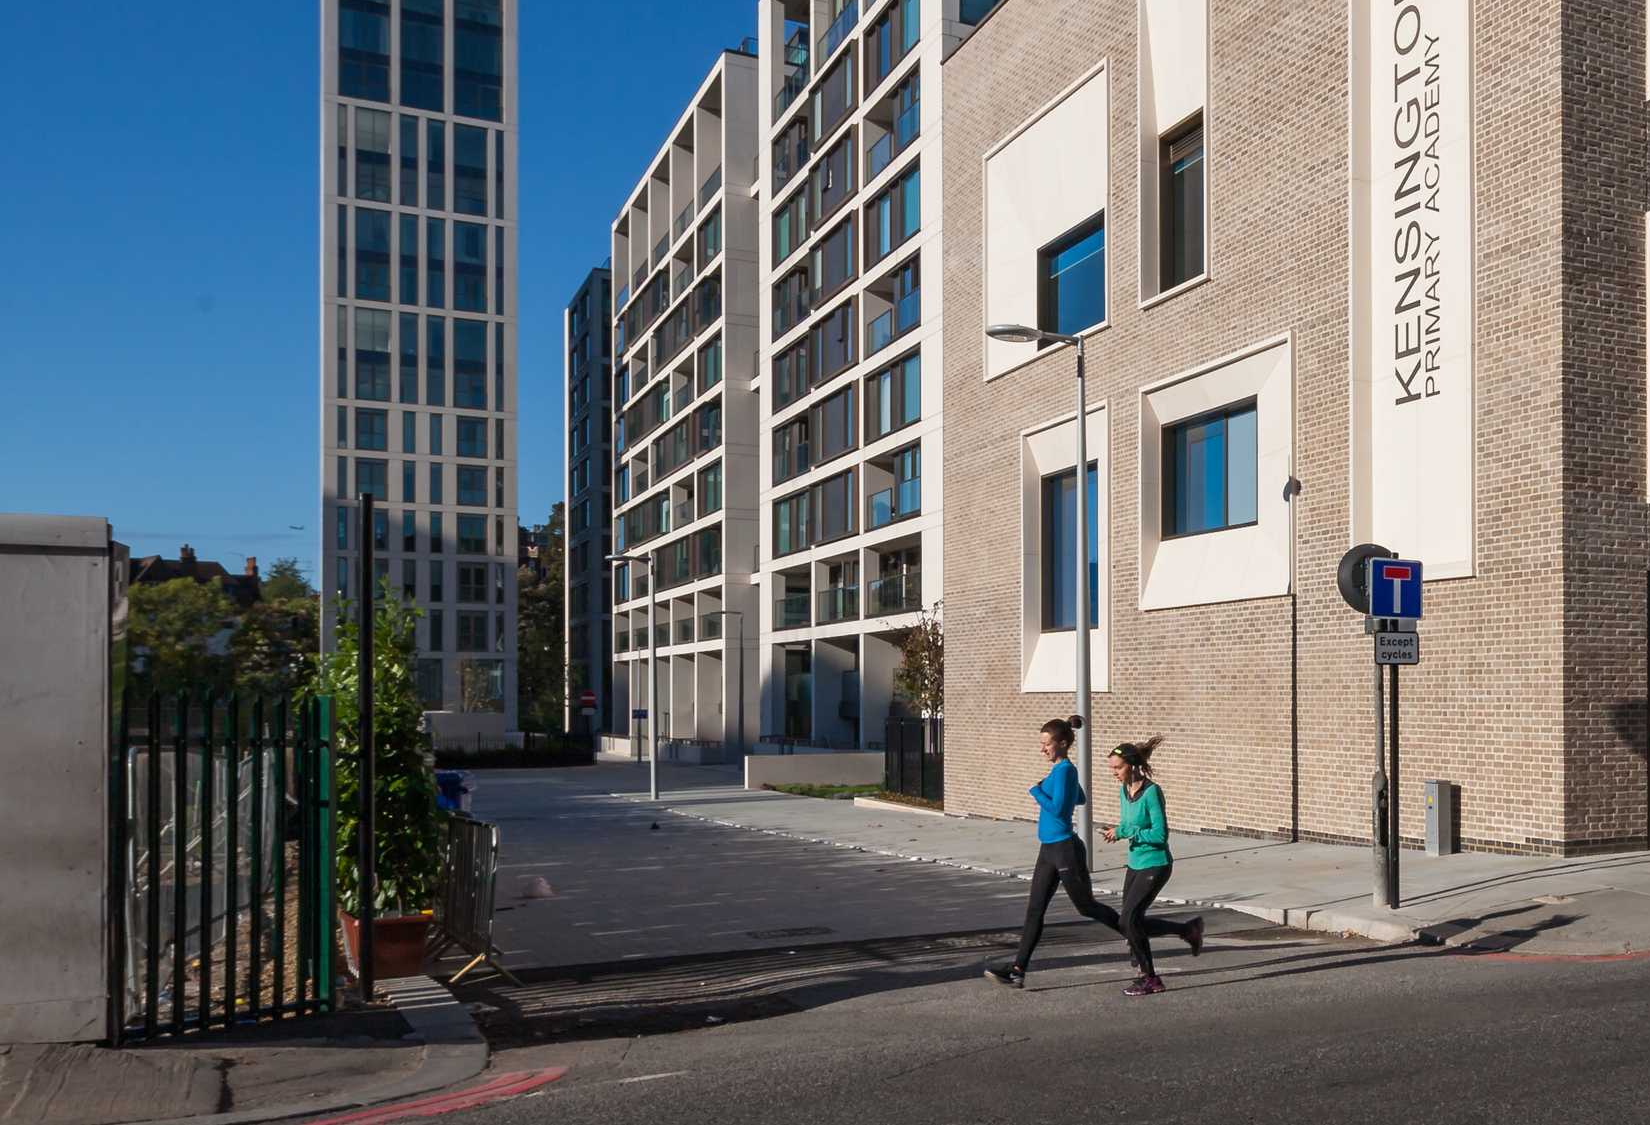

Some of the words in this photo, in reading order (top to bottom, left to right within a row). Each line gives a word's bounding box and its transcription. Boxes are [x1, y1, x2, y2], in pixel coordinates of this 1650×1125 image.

[1424, 33, 1441, 213] ACADEMY
[1424, 231, 1441, 397] PRIMARY
[1380, 636, 1414, 648] Except
[1381, 649, 1413, 661] cycles
